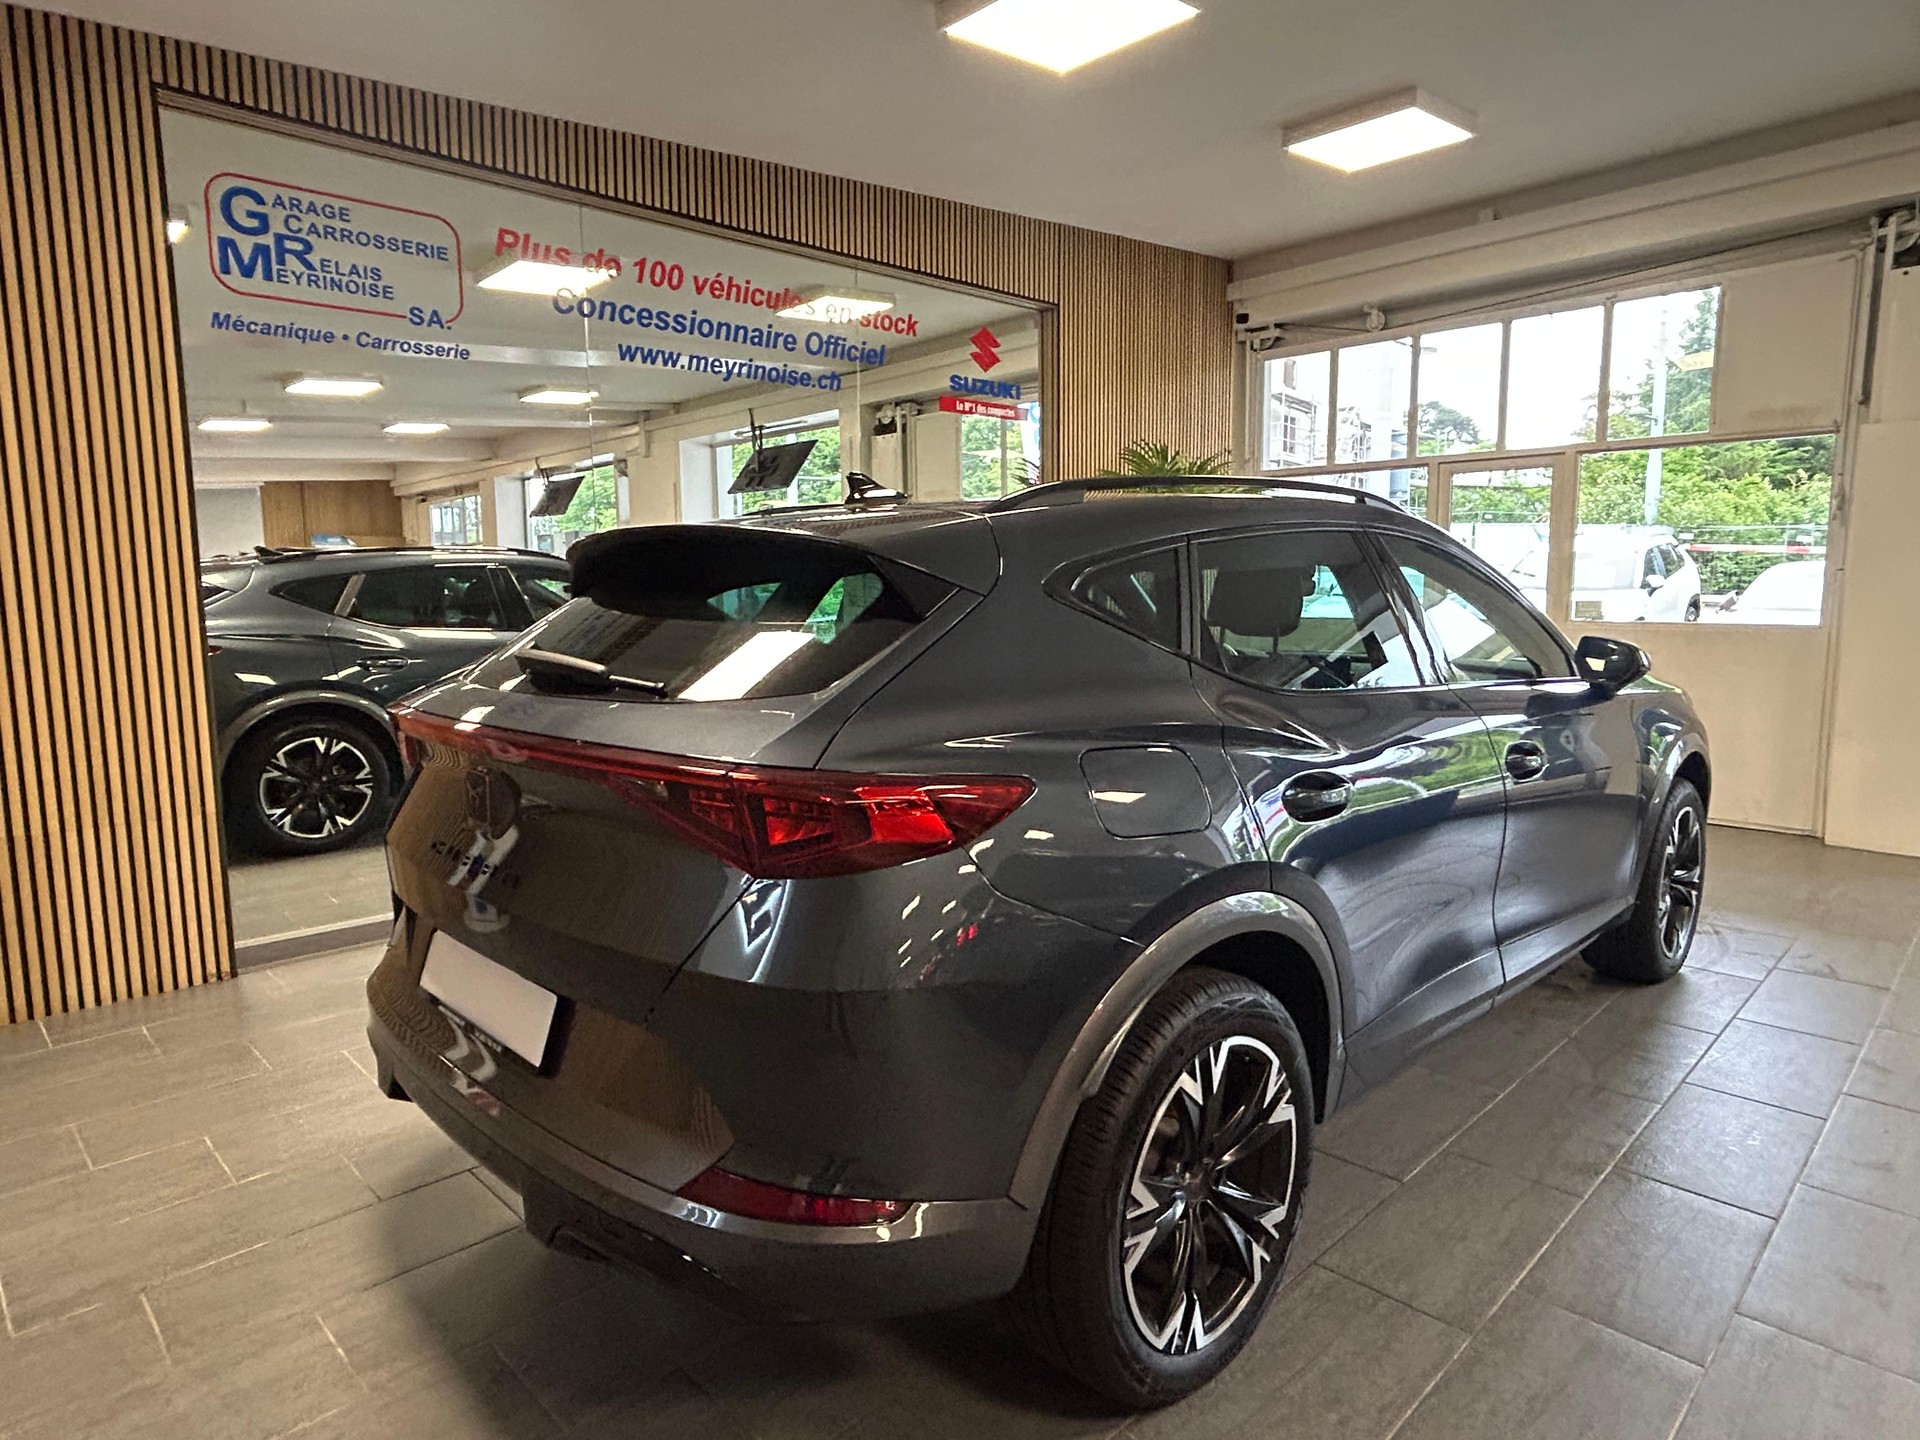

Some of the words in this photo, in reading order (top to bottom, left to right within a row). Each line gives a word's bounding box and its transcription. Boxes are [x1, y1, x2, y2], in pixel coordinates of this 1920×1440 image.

[219, 185, 352, 237] GARAGE
[272, 232, 383, 282] RELAIS
[283, 213, 449, 261] CARROSSERIE
[216, 235, 395, 300] MEYRINOISE
[495, 227, 571, 264] Plus
[583, 248, 622, 277] de
[633, 257, 684, 291] 100
[859, 313, 918, 337] stock
[211, 311, 335, 344] Mécanique
[356, 331, 471, 360] Carrosserie
[408, 306, 452, 330] SA.
[552, 288, 797, 352] Concessionnaire
[805, 331, 886, 367] Officiel
[618, 343, 841, 392] www.meyrinoise.ch
[949, 374, 1020, 400] SUZUKI
